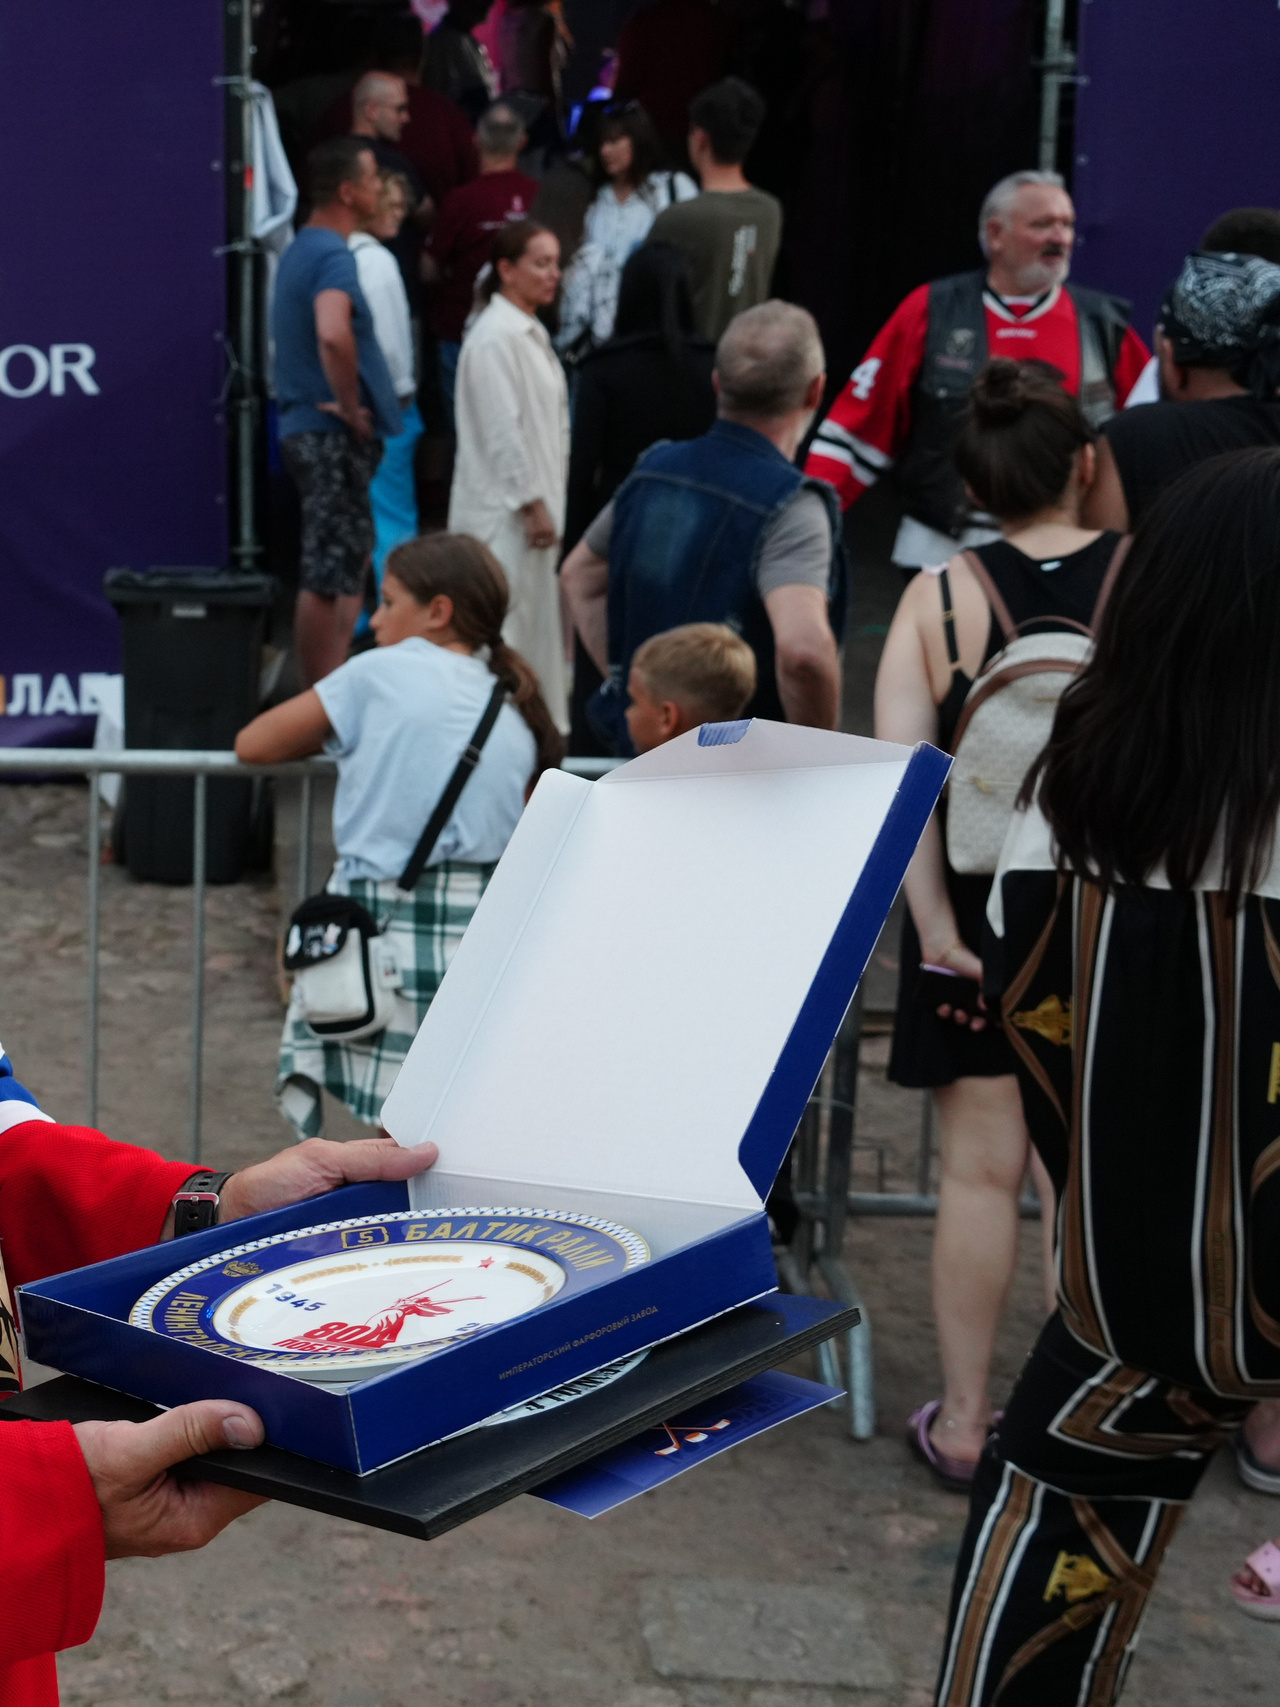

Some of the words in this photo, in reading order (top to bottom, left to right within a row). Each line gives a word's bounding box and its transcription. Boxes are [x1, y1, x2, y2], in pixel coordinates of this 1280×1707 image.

[404, 1221, 552, 1246] БАЛТИК
[546, 1231, 615, 1273] РАЛЛИ
[265, 1282, 327, 1312] 1945
[271, 1338, 360, 1353] ПОБЕД
[303, 1321, 372, 1344] 80
[499, 1341, 571, 1380] ИМПЕРАТОРСКИЙ
[572, 1315, 630, 1348] ФАРФОРОВЫЙ
[631, 1305, 659, 1323] ЗАВОД
